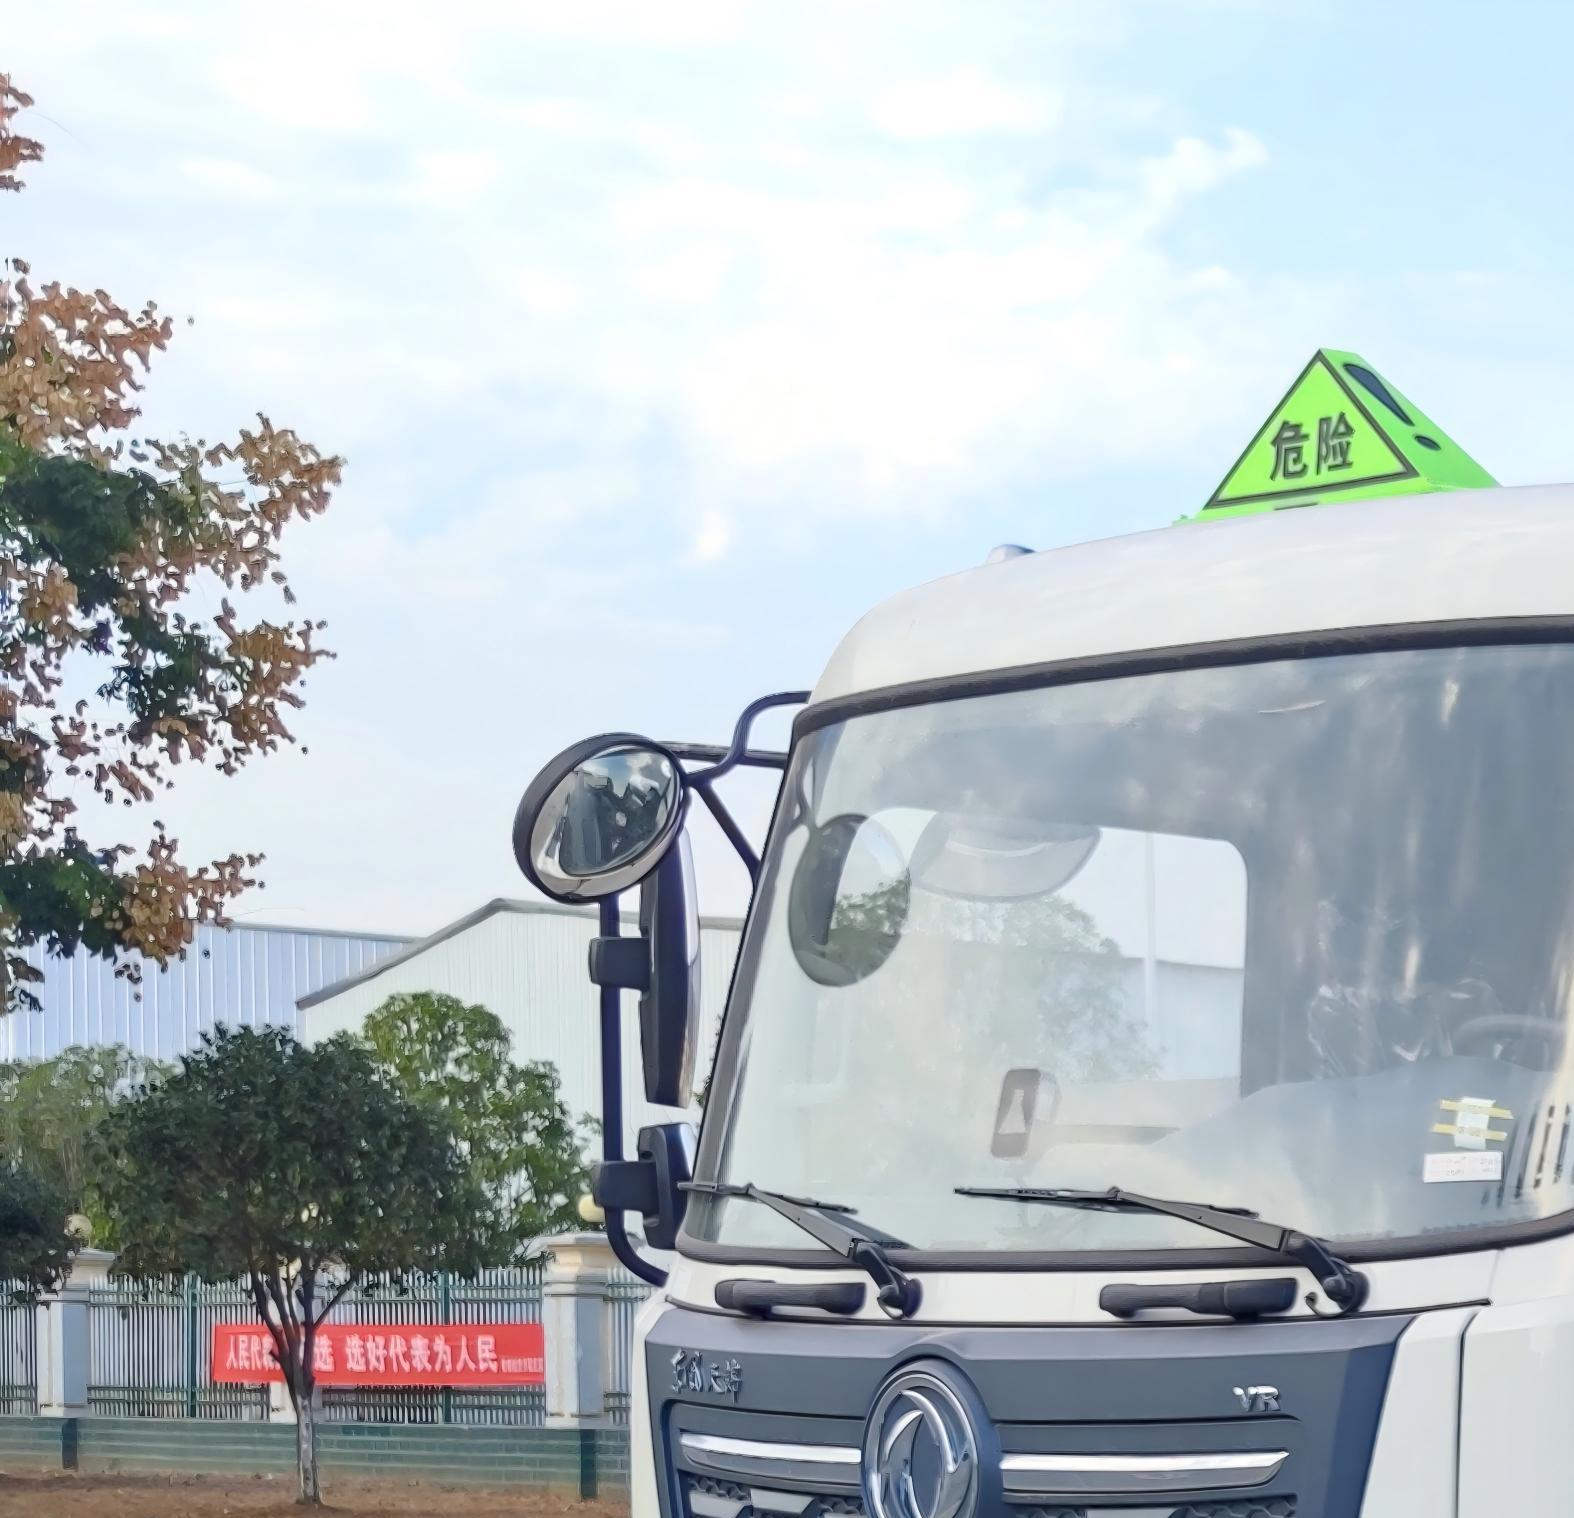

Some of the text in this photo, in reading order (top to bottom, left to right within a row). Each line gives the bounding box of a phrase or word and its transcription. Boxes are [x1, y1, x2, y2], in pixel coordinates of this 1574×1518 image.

[1269, 412, 1355, 481] 危险
[226, 1334, 334, 1372] 人民代表选
[346, 1334, 498, 1373] 选好代表为人民
